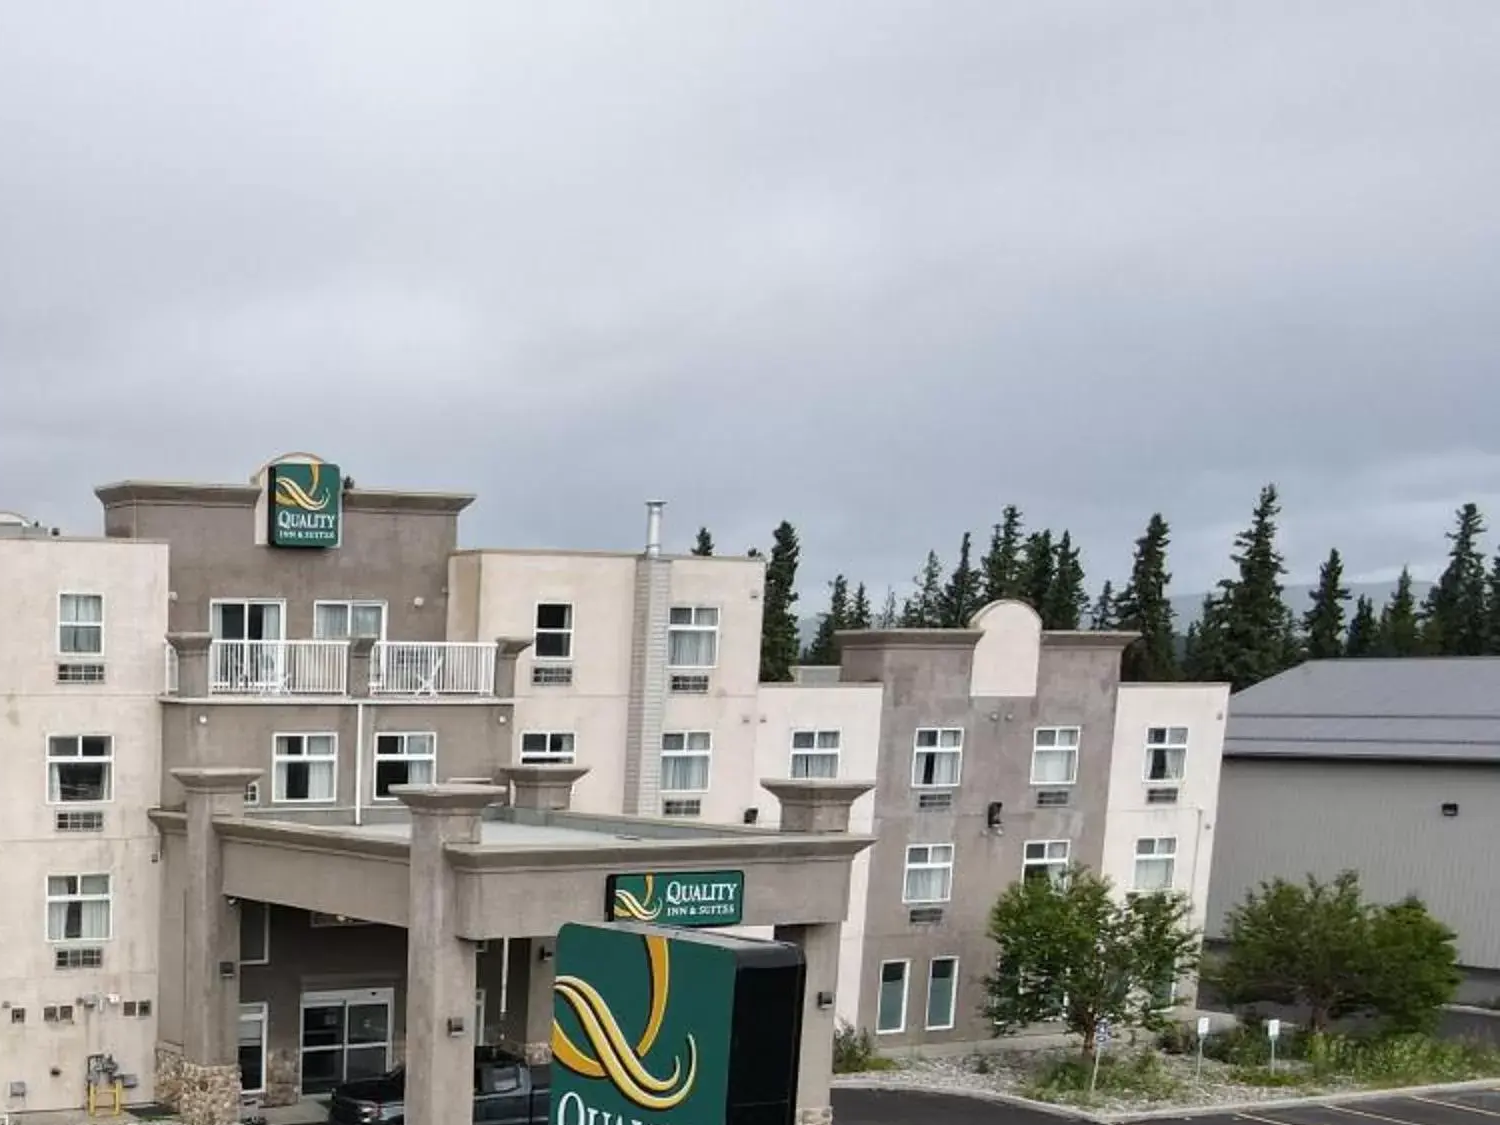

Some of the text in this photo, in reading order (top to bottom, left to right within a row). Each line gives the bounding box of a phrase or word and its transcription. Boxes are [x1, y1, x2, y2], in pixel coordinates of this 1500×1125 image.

[278, 510, 335, 529] QUALITY
[666, 881, 737, 905] QUALITY
[667, 904, 735, 917] INN & SUITES
